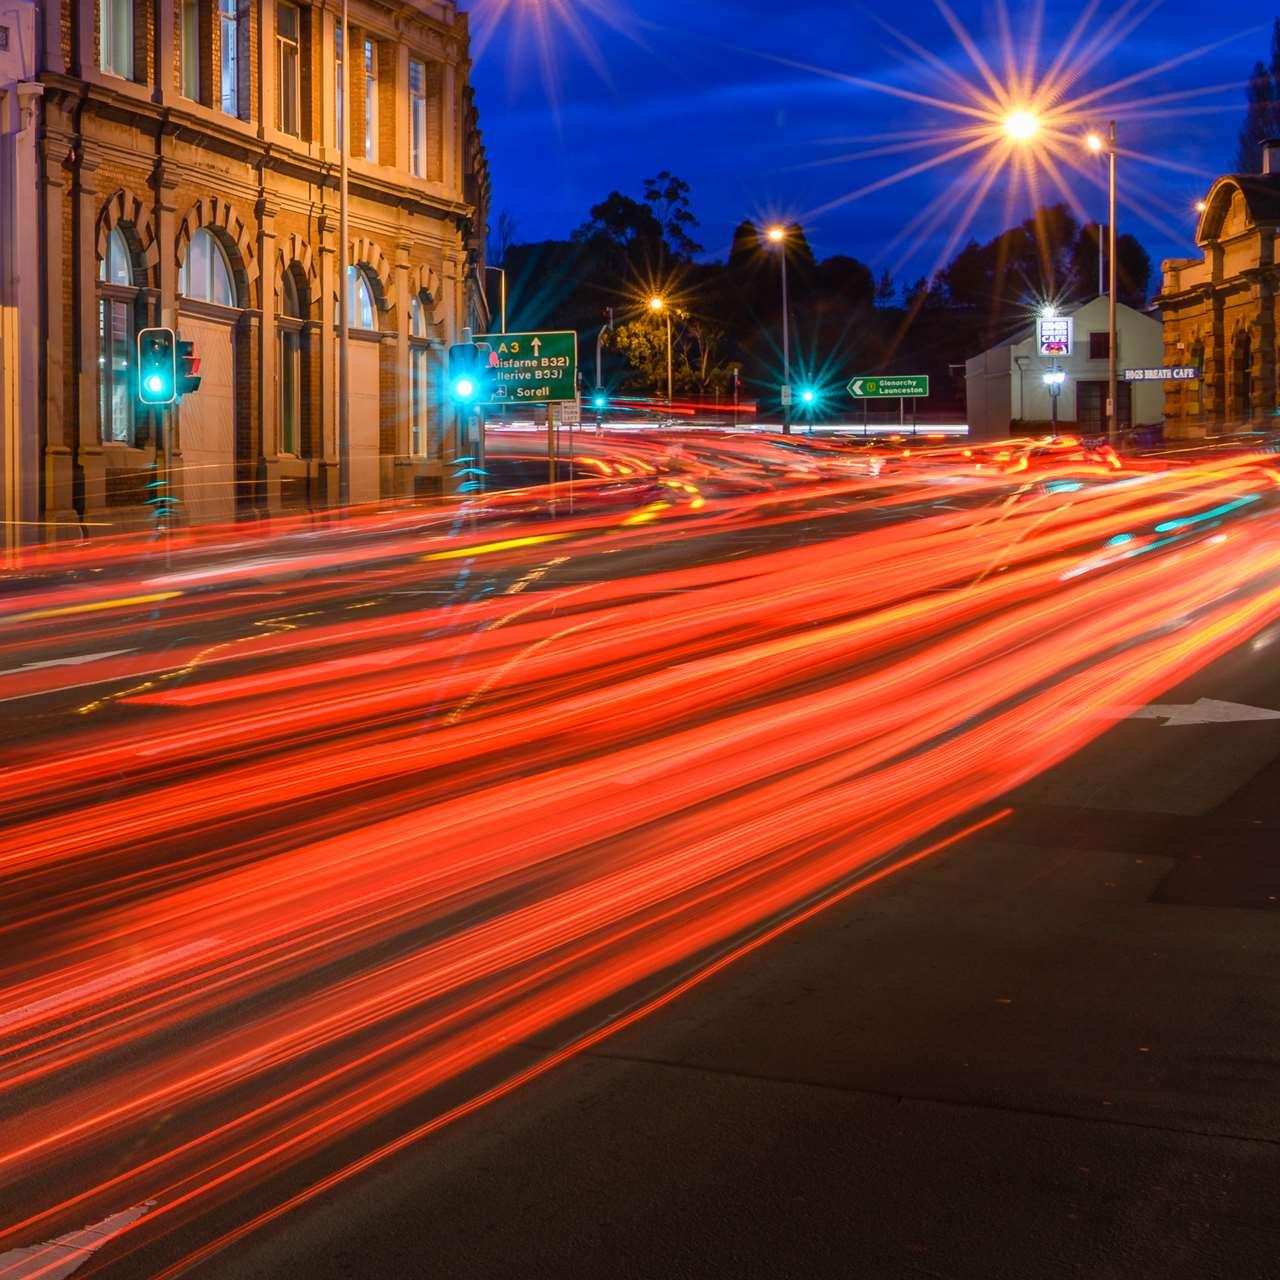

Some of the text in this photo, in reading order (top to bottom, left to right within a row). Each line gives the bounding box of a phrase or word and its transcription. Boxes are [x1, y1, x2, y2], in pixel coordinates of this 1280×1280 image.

[1042, 335, 1068, 343] CAFE
[494, 357, 570, 368] disfarne B32)
[1173, 368, 1195, 379] CAFE
[517, 386, 550, 397] Sorell
